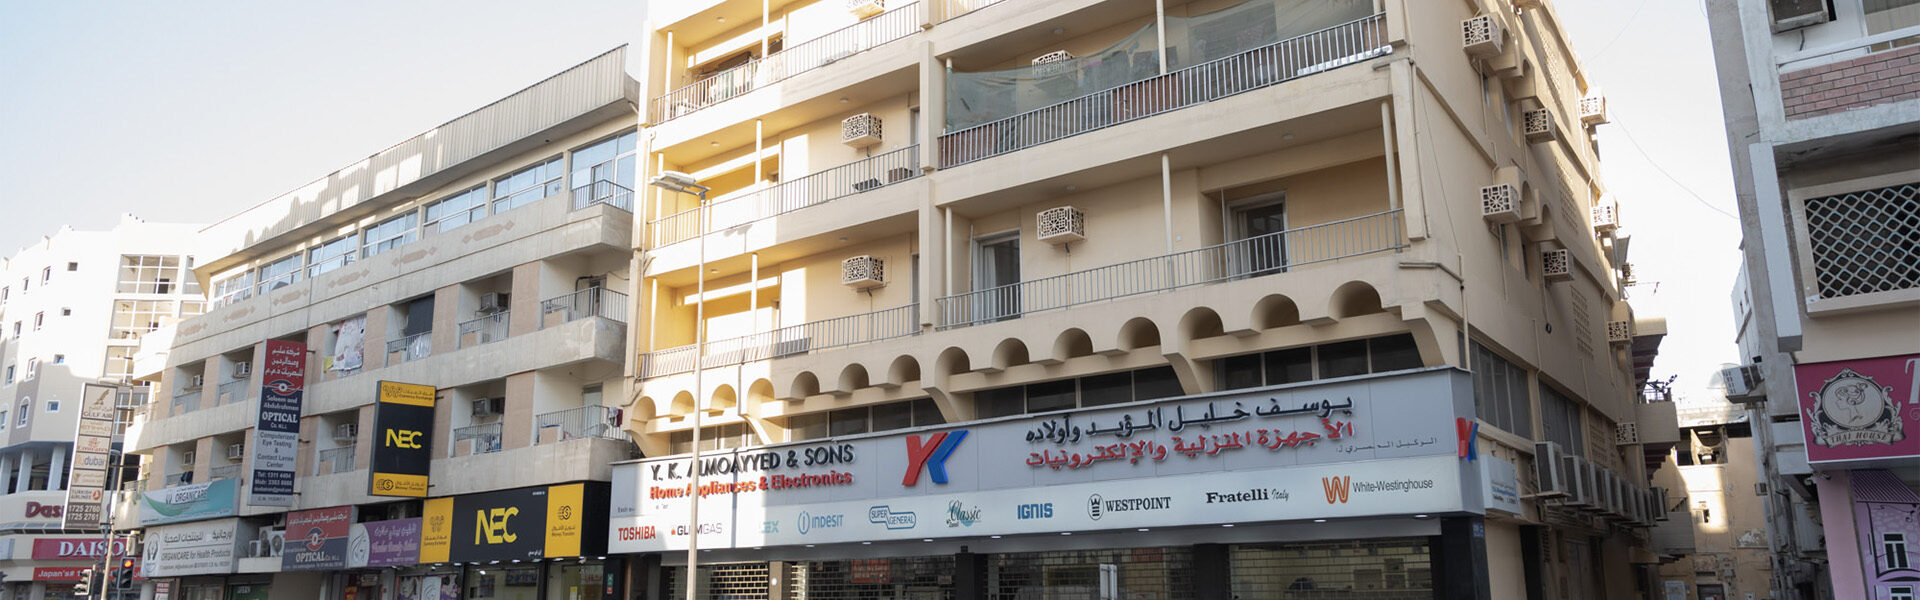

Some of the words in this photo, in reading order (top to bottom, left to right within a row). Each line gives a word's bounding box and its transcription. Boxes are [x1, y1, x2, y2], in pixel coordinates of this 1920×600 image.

[1168, 401, 1250, 432] خليل
[1256, 397, 1353, 418] يوسف
[262, 411, 298, 423] OPTICAL
[1085, 406, 1162, 437] المؤيد
[1026, 413, 1081, 444] وأولاده
[1257, 418, 1354, 449] الأجهزة
[1832, 432, 1852, 443] THAI
[1856, 431, 1888, 441] HOUSE
[385, 428, 422, 448] NEC
[1172, 431, 1250, 457] المنزلية
[786, 450, 798, 468] &
[804, 444, 854, 466] SONS
[1026, 440, 1167, 469] والإلكترونيات
[650, 486, 684, 499] Home
[759, 476, 768, 490] &
[771, 470, 853, 490] Electronics
[1352, 478, 1433, 494] White-Westinghouse
[1105, 496, 1171, 512] WESTPOINT
[1206, 489, 1269, 504] Fratelli
[1271, 488, 1290, 502] Italy
[871, 510, 888, 520] SUPER
[948, 500, 981, 521] Classic
[1017, 503, 1054, 520] IGNIS
[474, 506, 519, 545] NEC
[677, 523, 722, 536] GLMGAS
[888, 515, 914, 526] GENERAL
[618, 525, 656, 541] TOSHIBA
[58, 541, 124, 556] DAISO
[296, 552, 325, 562] OPTICAL
